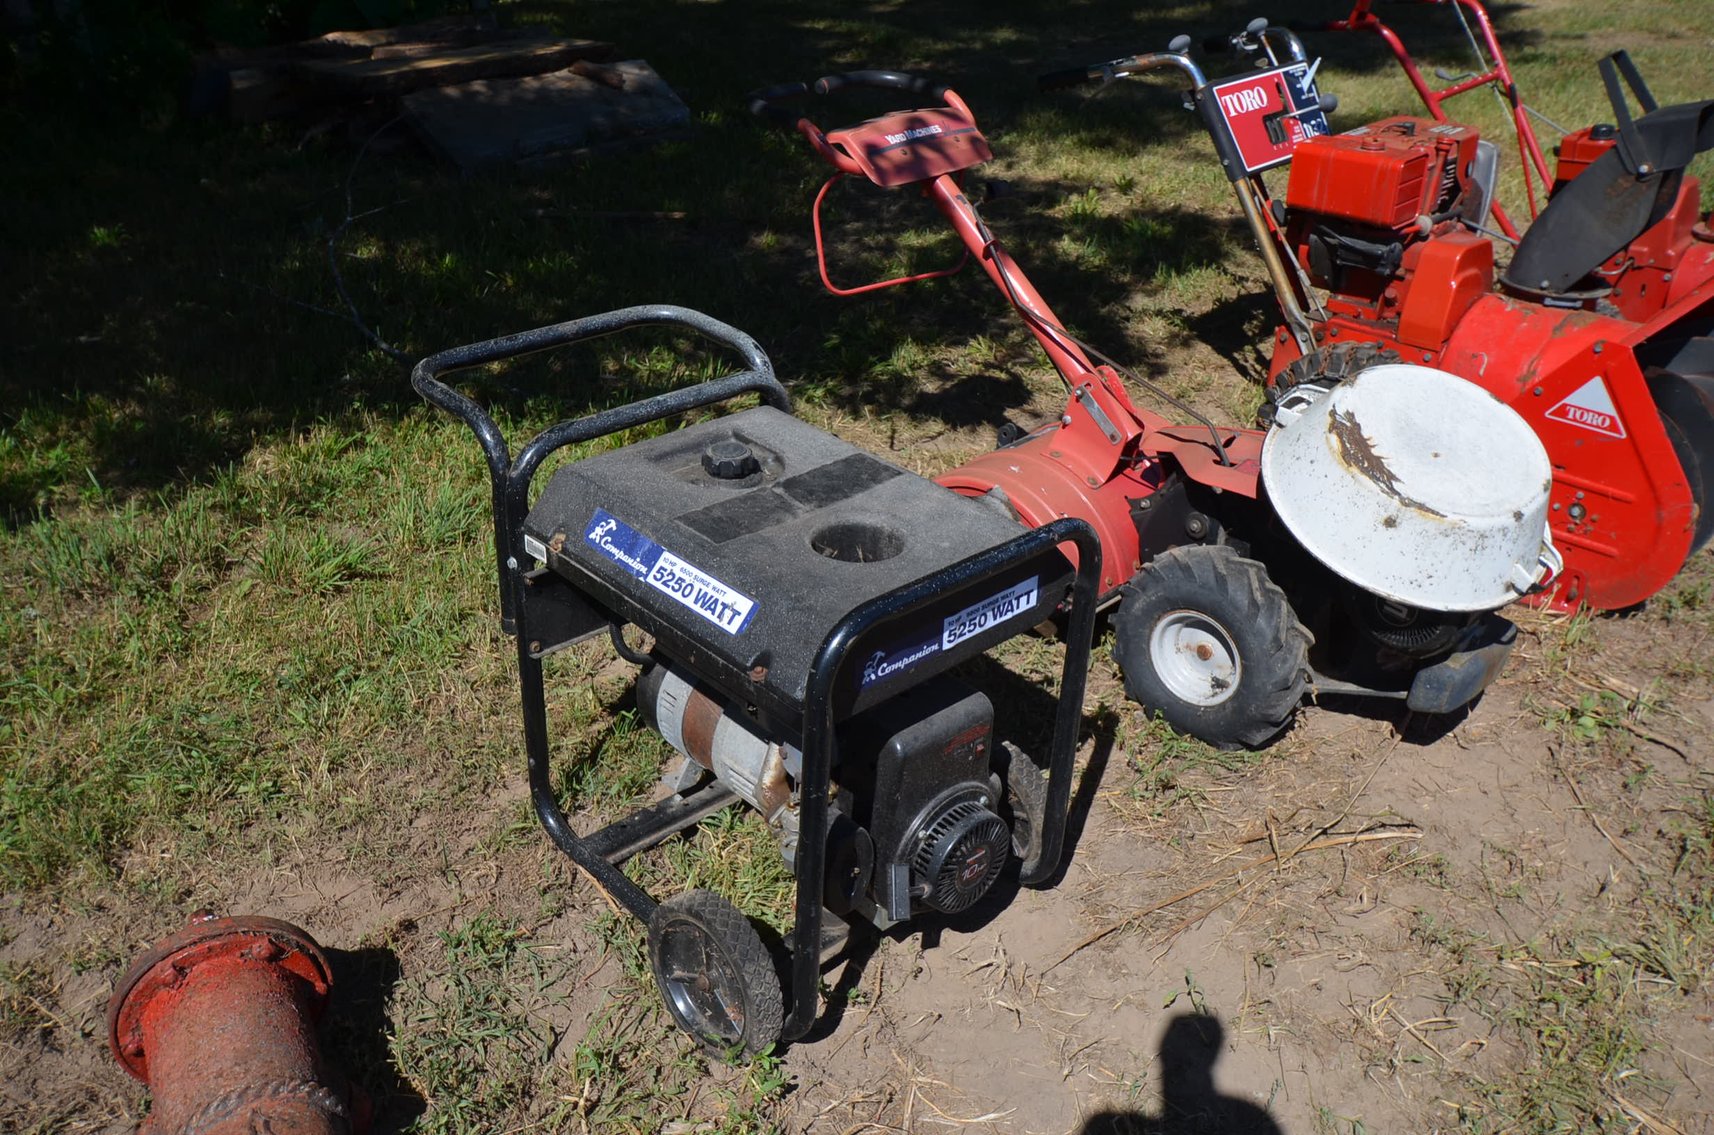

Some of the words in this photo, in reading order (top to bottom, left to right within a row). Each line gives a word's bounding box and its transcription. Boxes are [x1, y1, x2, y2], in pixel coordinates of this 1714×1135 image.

[1221, 86, 1268, 117] TORO
[1566, 405, 1611, 428] TORO
[601, 536, 649, 575] Companion
[652, 565, 695, 598] 5250
[693, 587, 742, 626] WATT
[669, 559, 678, 568] HP
[679, 567, 693, 578] 6500
[692, 574, 711, 588] SURGE
[711, 584, 727, 597] WATT
[946, 613, 988, 644] 5250
[990, 588, 1035, 621] WATT
[877, 642, 940, 677] Companion
